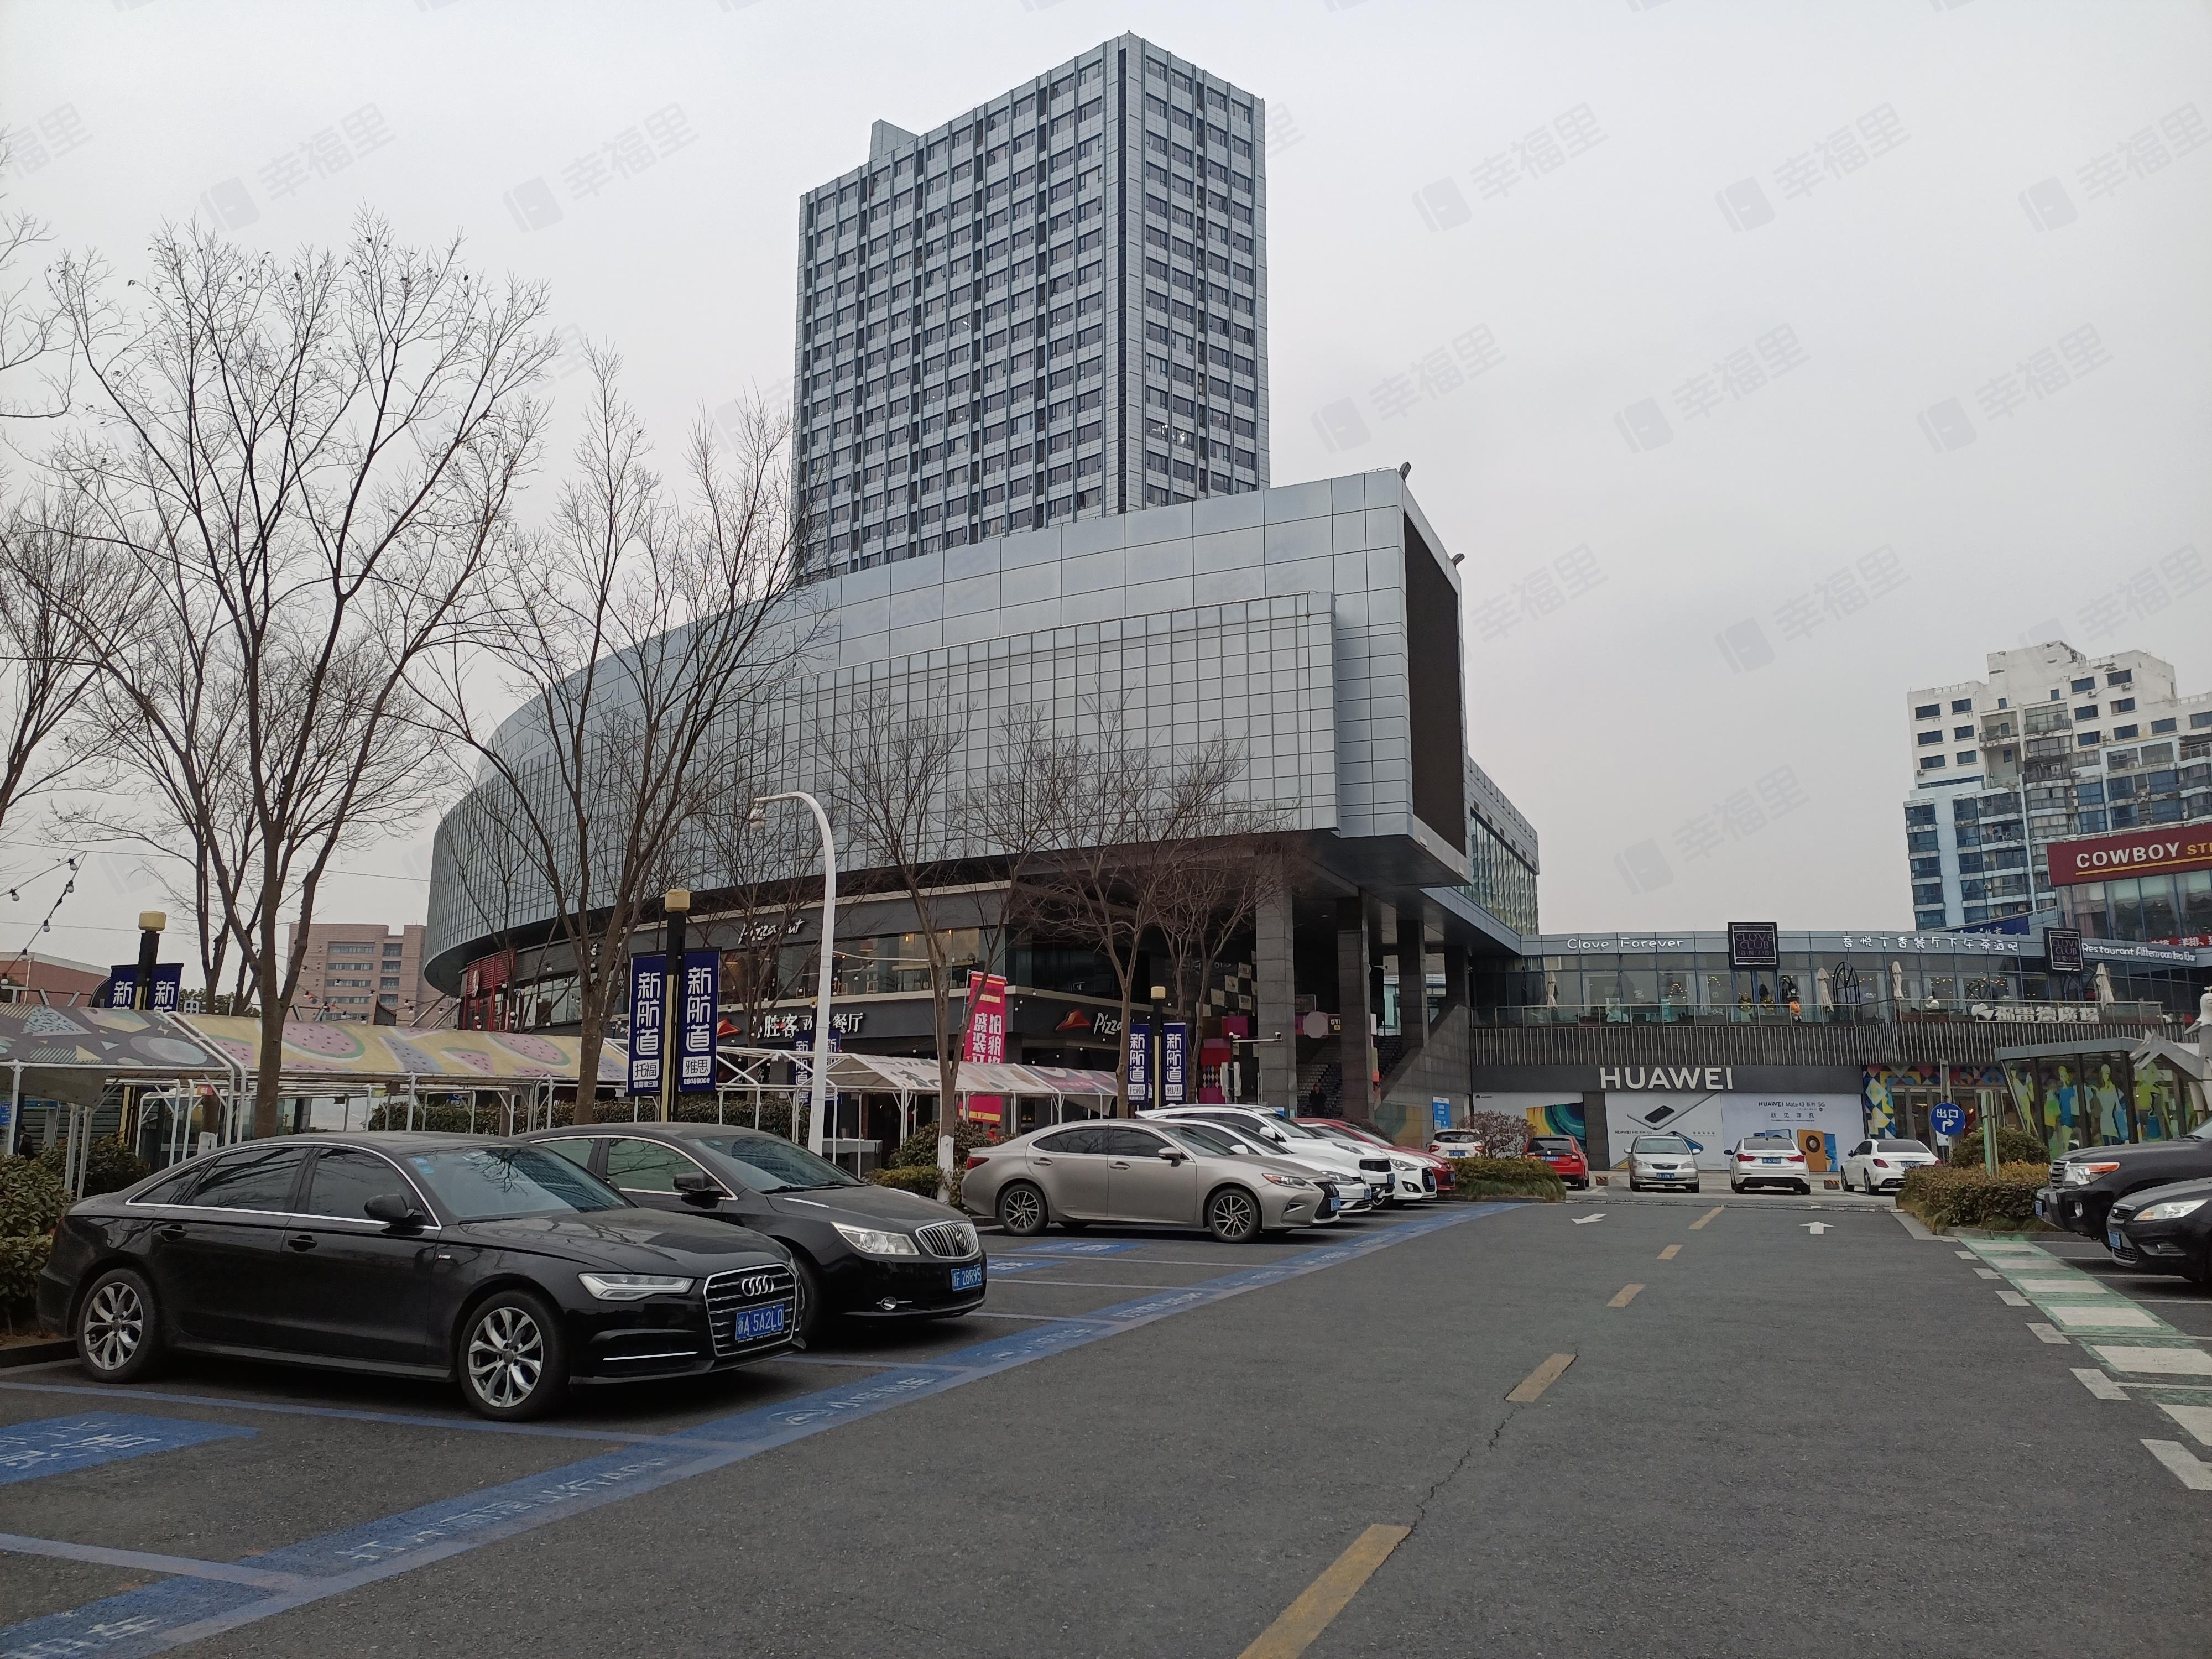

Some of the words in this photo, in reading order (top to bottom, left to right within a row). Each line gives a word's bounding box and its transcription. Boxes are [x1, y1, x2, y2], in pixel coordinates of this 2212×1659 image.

[2076, 842, 2179, 868] COWBOY
[1567, 938, 1609, 950] Clove
[1620, 937, 1684, 948] Forever
[1740, 941, 1769, 950] CLUB
[2082, 942, 2134, 956] Restaurant
[112, 981, 133, 1010] 新
[154, 981, 176, 1011] 新
[636, 972, 661, 1056] 新航道
[686, 967, 712, 1052] 新航道
[685, 1058, 709, 1074] 雅思
[1130, 1033, 1145, 1082] 新航道
[1166, 1033, 1182, 1082] 新航道
[634, 1062, 657, 1078] 托福
[1600, 1067, 1733, 1089] HUAWEI
[1936, 1108, 1959, 1118] 出口
